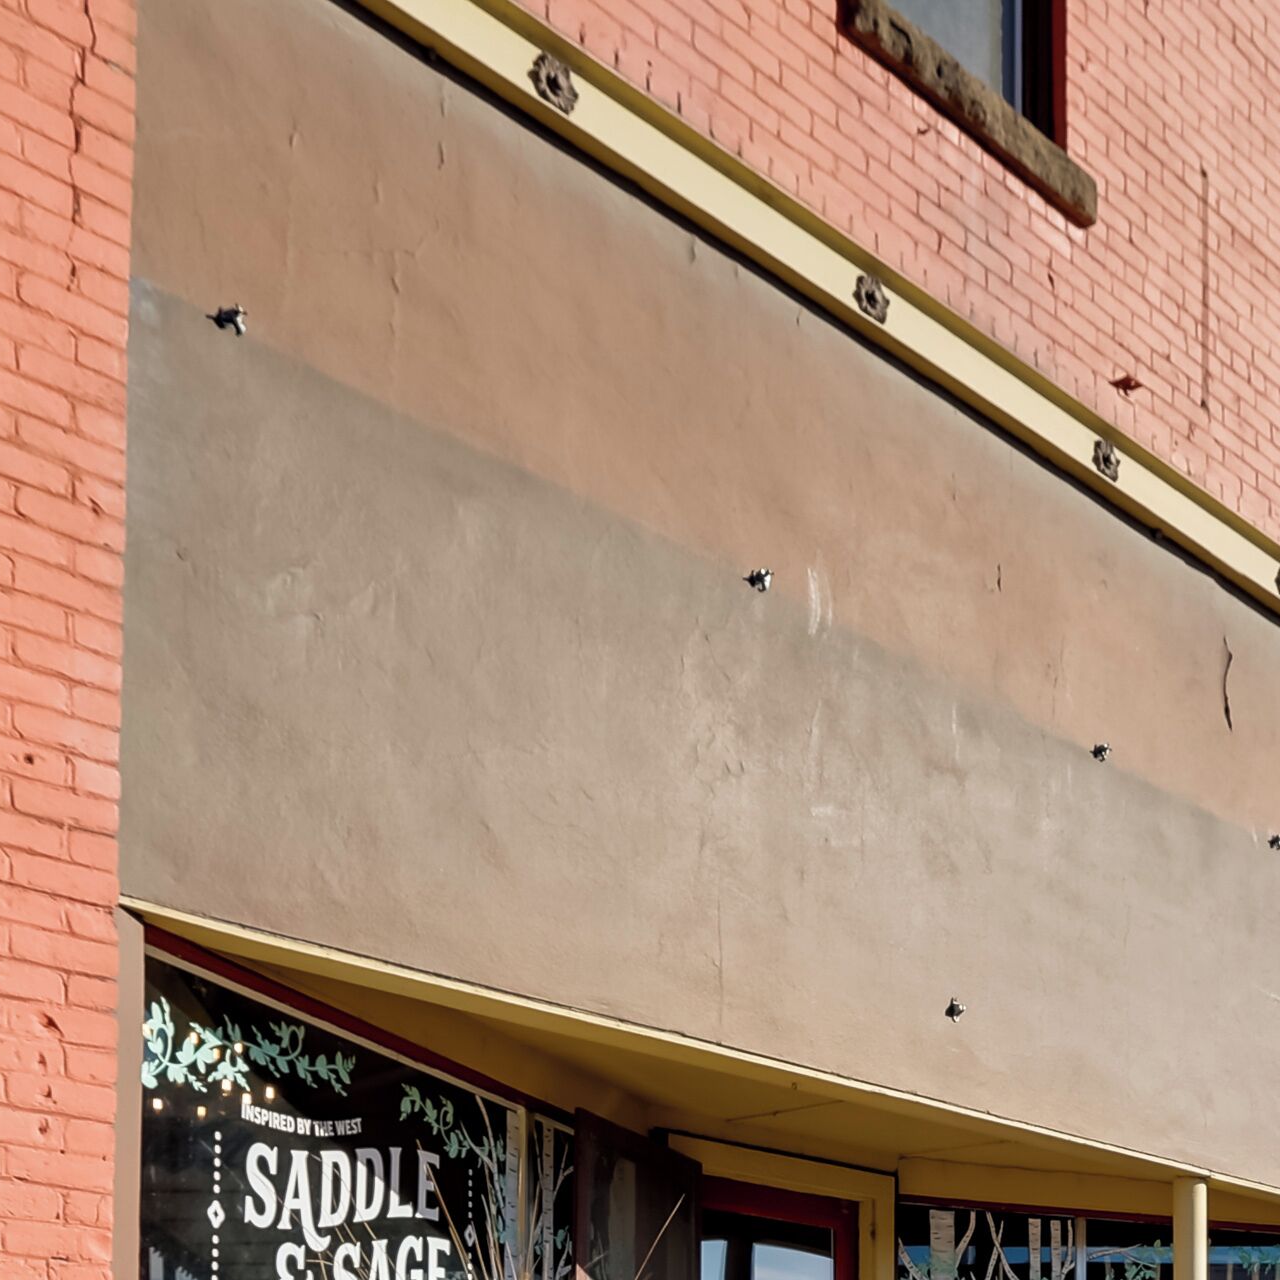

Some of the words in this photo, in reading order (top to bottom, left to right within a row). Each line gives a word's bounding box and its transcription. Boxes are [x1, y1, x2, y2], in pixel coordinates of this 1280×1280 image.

[241, 1103, 295, 1133] INSPIRED
[297, 1117, 311, 1135] BY
[313, 1120, 334, 1137] THE
[334, 1117, 362, 1136] WEST
[244, 1142, 440, 1252] SADDLE
